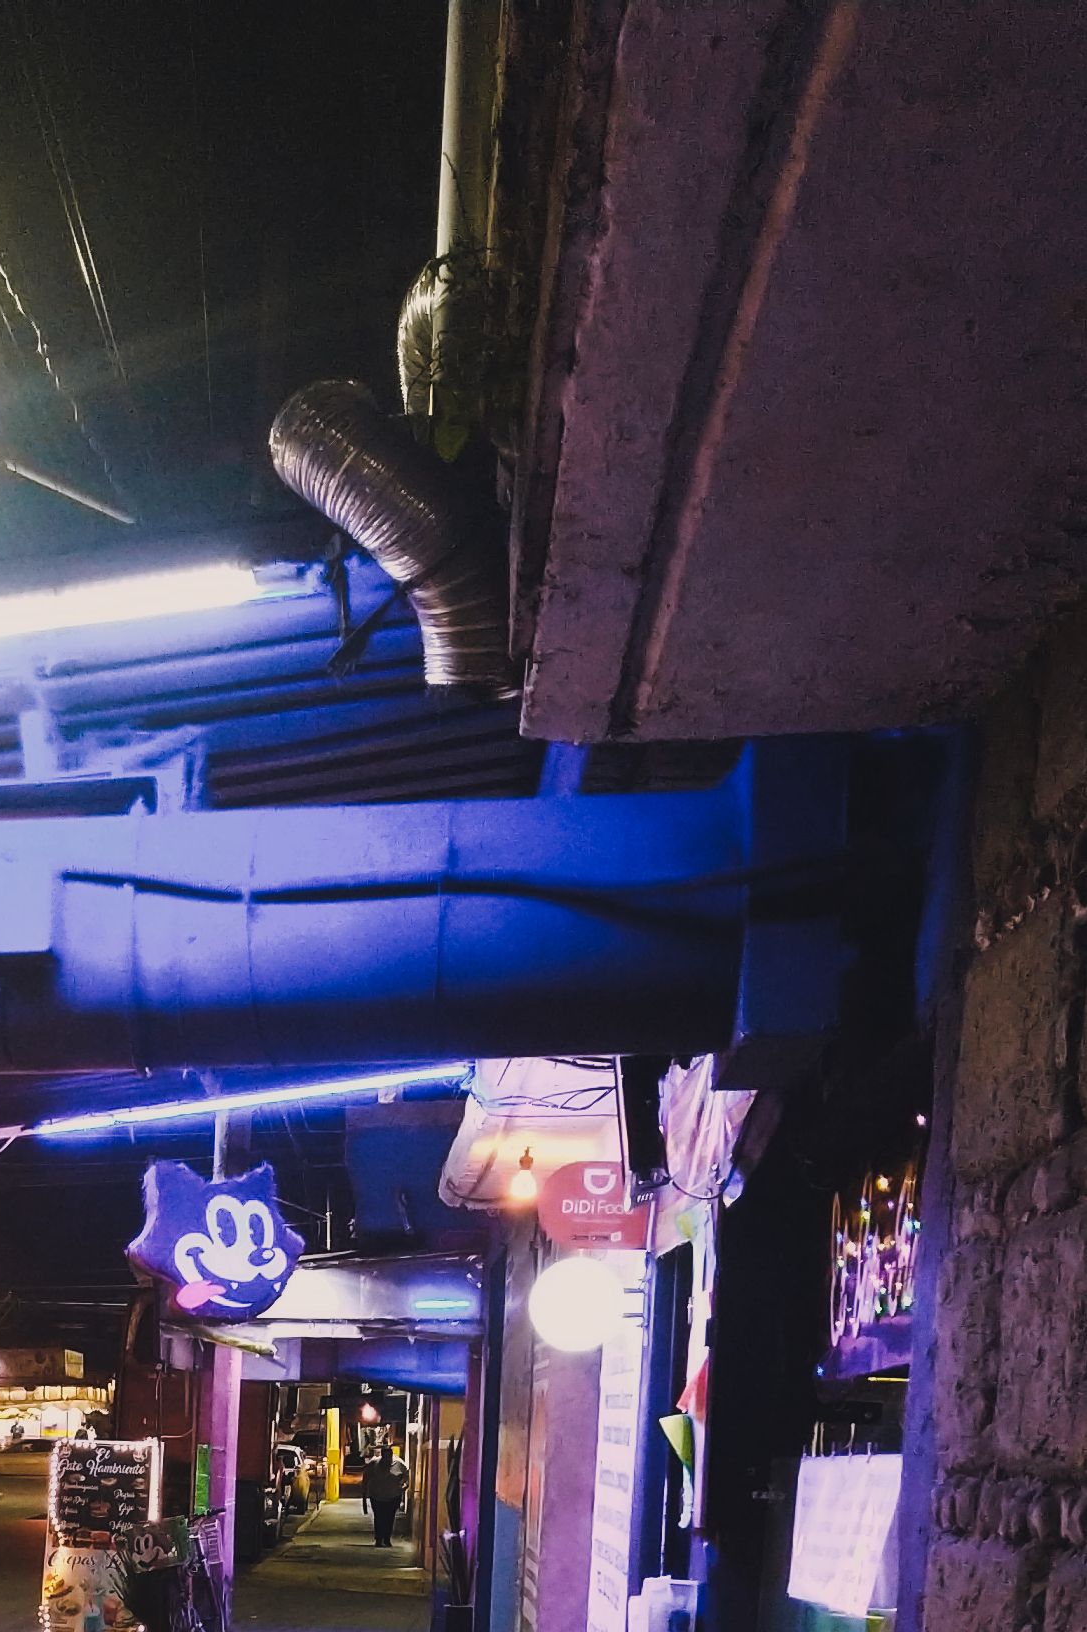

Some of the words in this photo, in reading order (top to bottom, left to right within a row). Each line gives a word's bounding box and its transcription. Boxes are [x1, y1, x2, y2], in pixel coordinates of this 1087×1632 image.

[561, 1199, 595, 1214] DiDi
[96, 1447, 111, 1462] El
[57, 1458, 83, 1480] Gato
[86, 1459, 146, 1477] Hambriento
[47, 1550, 96, 1572] Cepas
